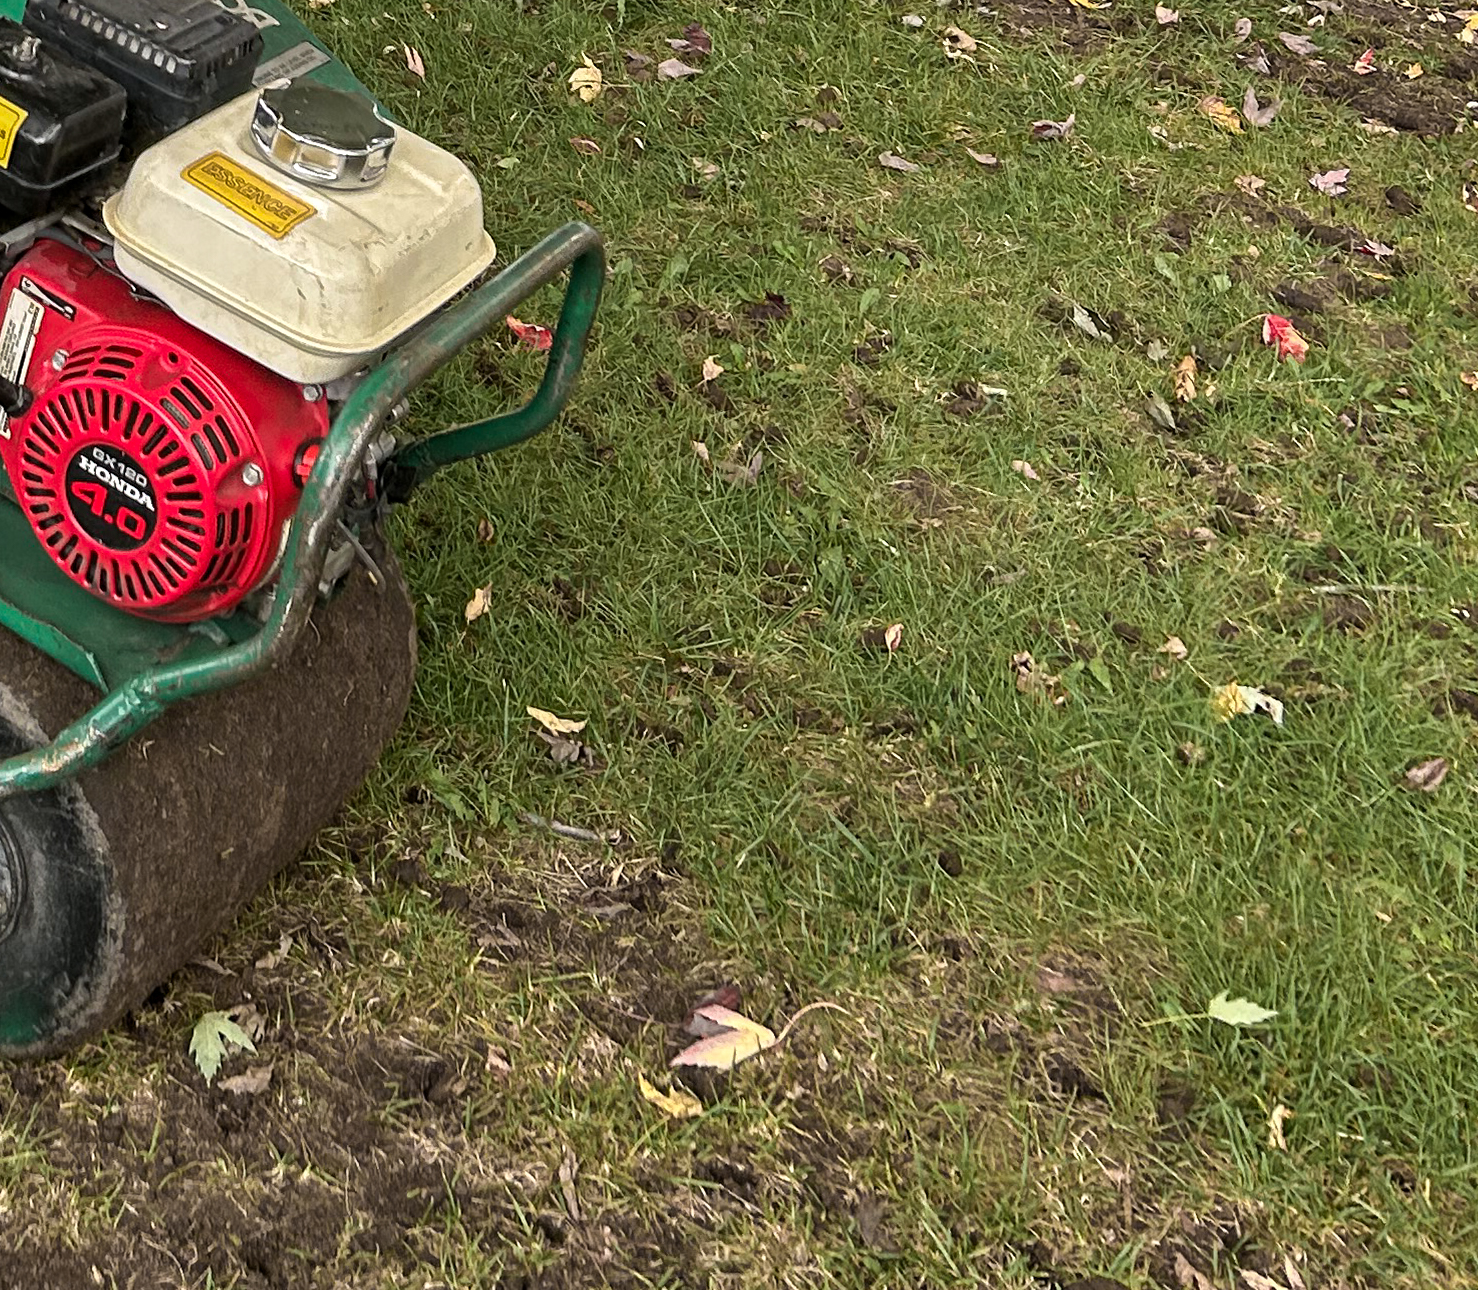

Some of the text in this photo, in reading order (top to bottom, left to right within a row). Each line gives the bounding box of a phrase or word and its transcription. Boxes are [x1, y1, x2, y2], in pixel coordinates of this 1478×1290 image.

[201, 161, 298, 221] ESSENCE
[78, 454, 155, 512] HONDA
[92, 446, 148, 488] GX120
[70, 481, 147, 540] 4.0
